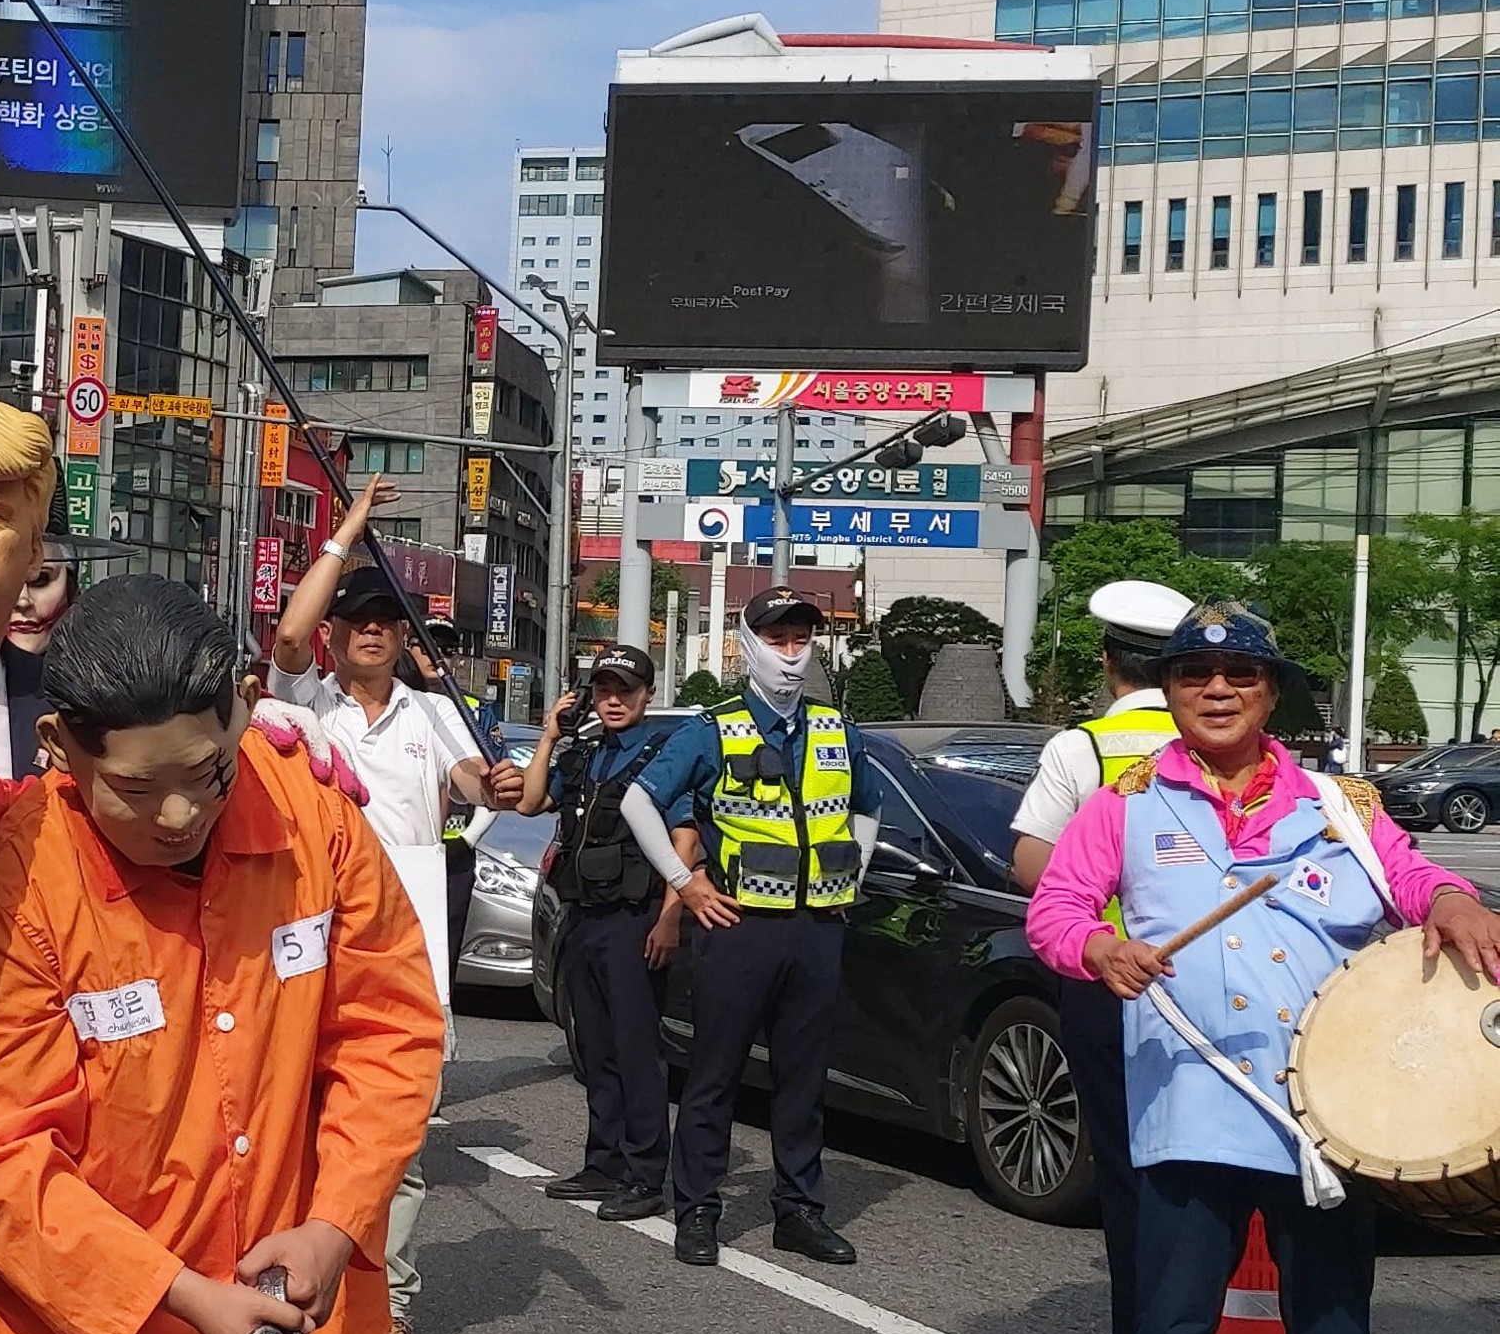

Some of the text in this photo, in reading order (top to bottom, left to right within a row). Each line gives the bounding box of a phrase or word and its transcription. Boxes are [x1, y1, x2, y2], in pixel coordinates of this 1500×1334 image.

[733, 284, 791, 299] Post Pay
[75, 388, 100, 412] 50
[812, 380, 954, 403] 서울중앙우체국
[772, 510, 951, 536] 부세무서
[815, 533, 851, 545] Jungbu
[856, 533, 893, 545] District
[899, 535, 929, 546] Office
[598, 657, 636, 669] POLICE
